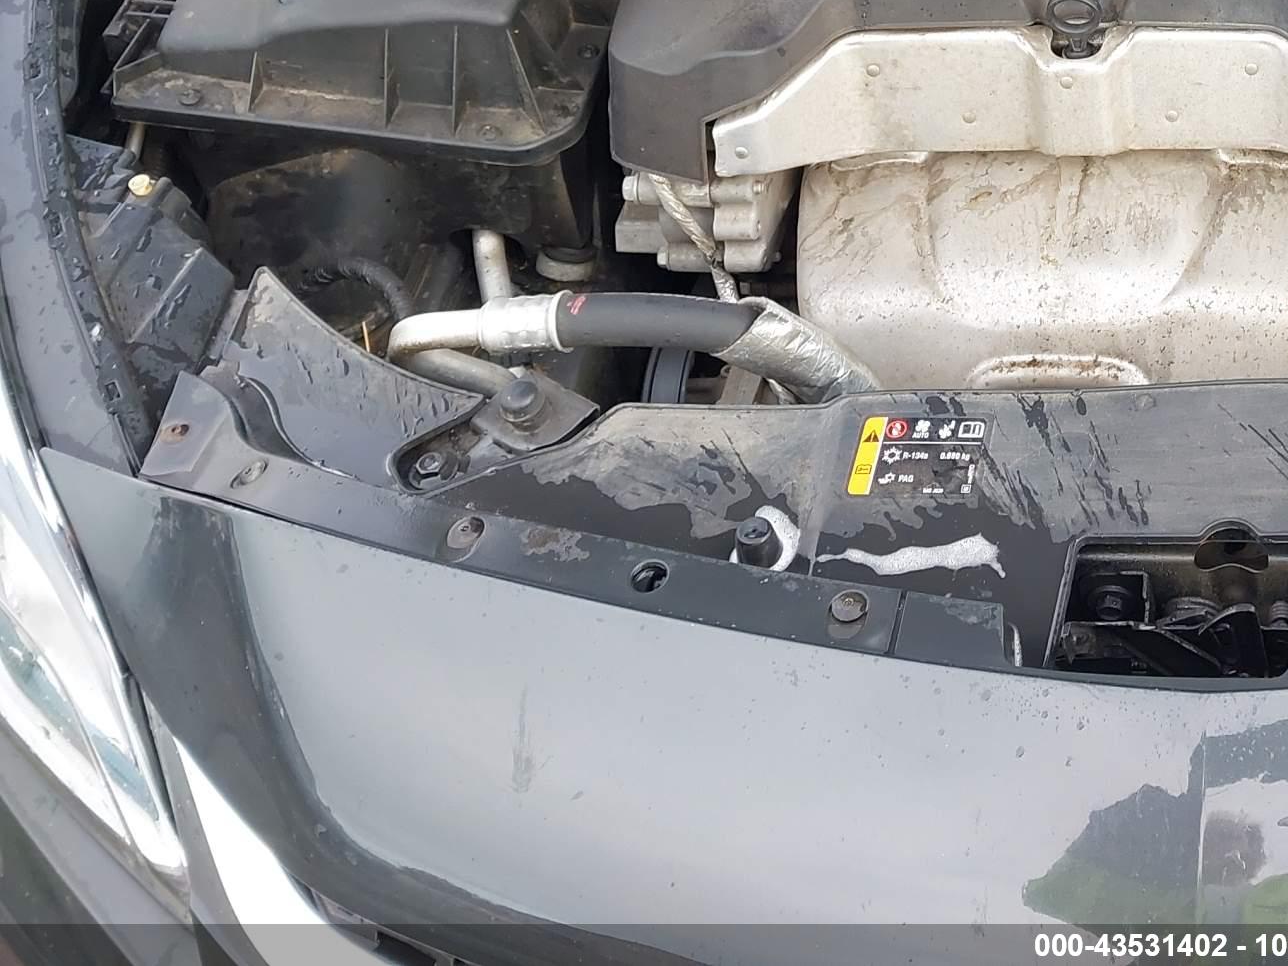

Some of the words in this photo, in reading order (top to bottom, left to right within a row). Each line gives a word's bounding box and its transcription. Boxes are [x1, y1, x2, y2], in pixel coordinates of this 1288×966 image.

[902, 451, 929, 460] R-134a
[960, 451, 971, 462] kg
[898, 474, 914, 483] PAG
